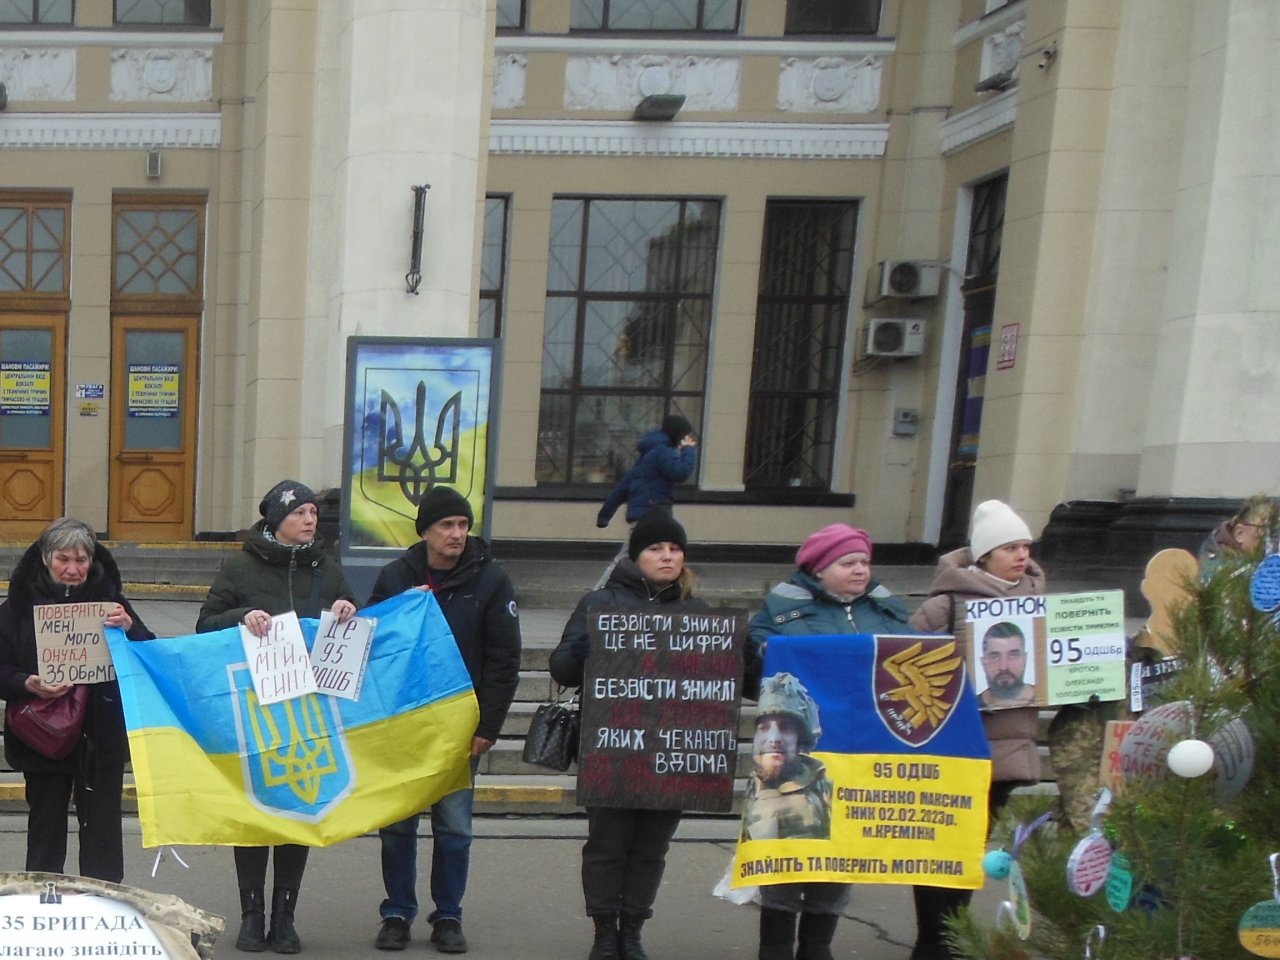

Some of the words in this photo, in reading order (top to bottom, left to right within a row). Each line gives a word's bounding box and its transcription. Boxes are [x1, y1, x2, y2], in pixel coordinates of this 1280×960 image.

[38, 604, 106, 621] ПОВЕРНІТЬ
[966, 596, 1046, 619] КРОТЮК
[1056, 608, 1112, 619] ПОВЕРНІТЬ
[40, 619, 75, 634] МЕНІ
[598, 613, 672, 631] БЕЗВІСТИ
[680, 616, 736, 634] ЗНИКЛІ
[64, 633, 100, 646] МОГО
[604, 633, 627, 652] ЦЕ
[634, 634, 657, 650] НЕ
[670, 634, 733, 654] ЦИФРИ
[42, 647, 88, 664] ОНУКА
[319, 642, 348, 664] 95
[1050, 637, 1083, 664] 95
[594, 677, 676, 700] БЕЗВІСТИ
[682, 678, 736, 701] ЗНИКЛІ
[596, 728, 646, 751] ЯКИХ
[658, 729, 737, 751] ЧЕКАЮТЬ
[656, 752, 728, 774] ВДОМА
[873, 762, 893, 779] 95
[897, 763, 940, 782] ОДШБ
[920, 791, 973, 810] МАКСИМ
[845, 806, 876, 820] ЗНИК
[740, 856, 804, 878] ЗНАЙДІТЬ
[806, 856, 824, 872] ТА
[825, 856, 888, 874] ПОВЕРНІТЬ
[1, 915, 25, 931] 35
[32, 915, 145, 933] БРИГАДА
[70, 941, 163, 958] знайдіть
